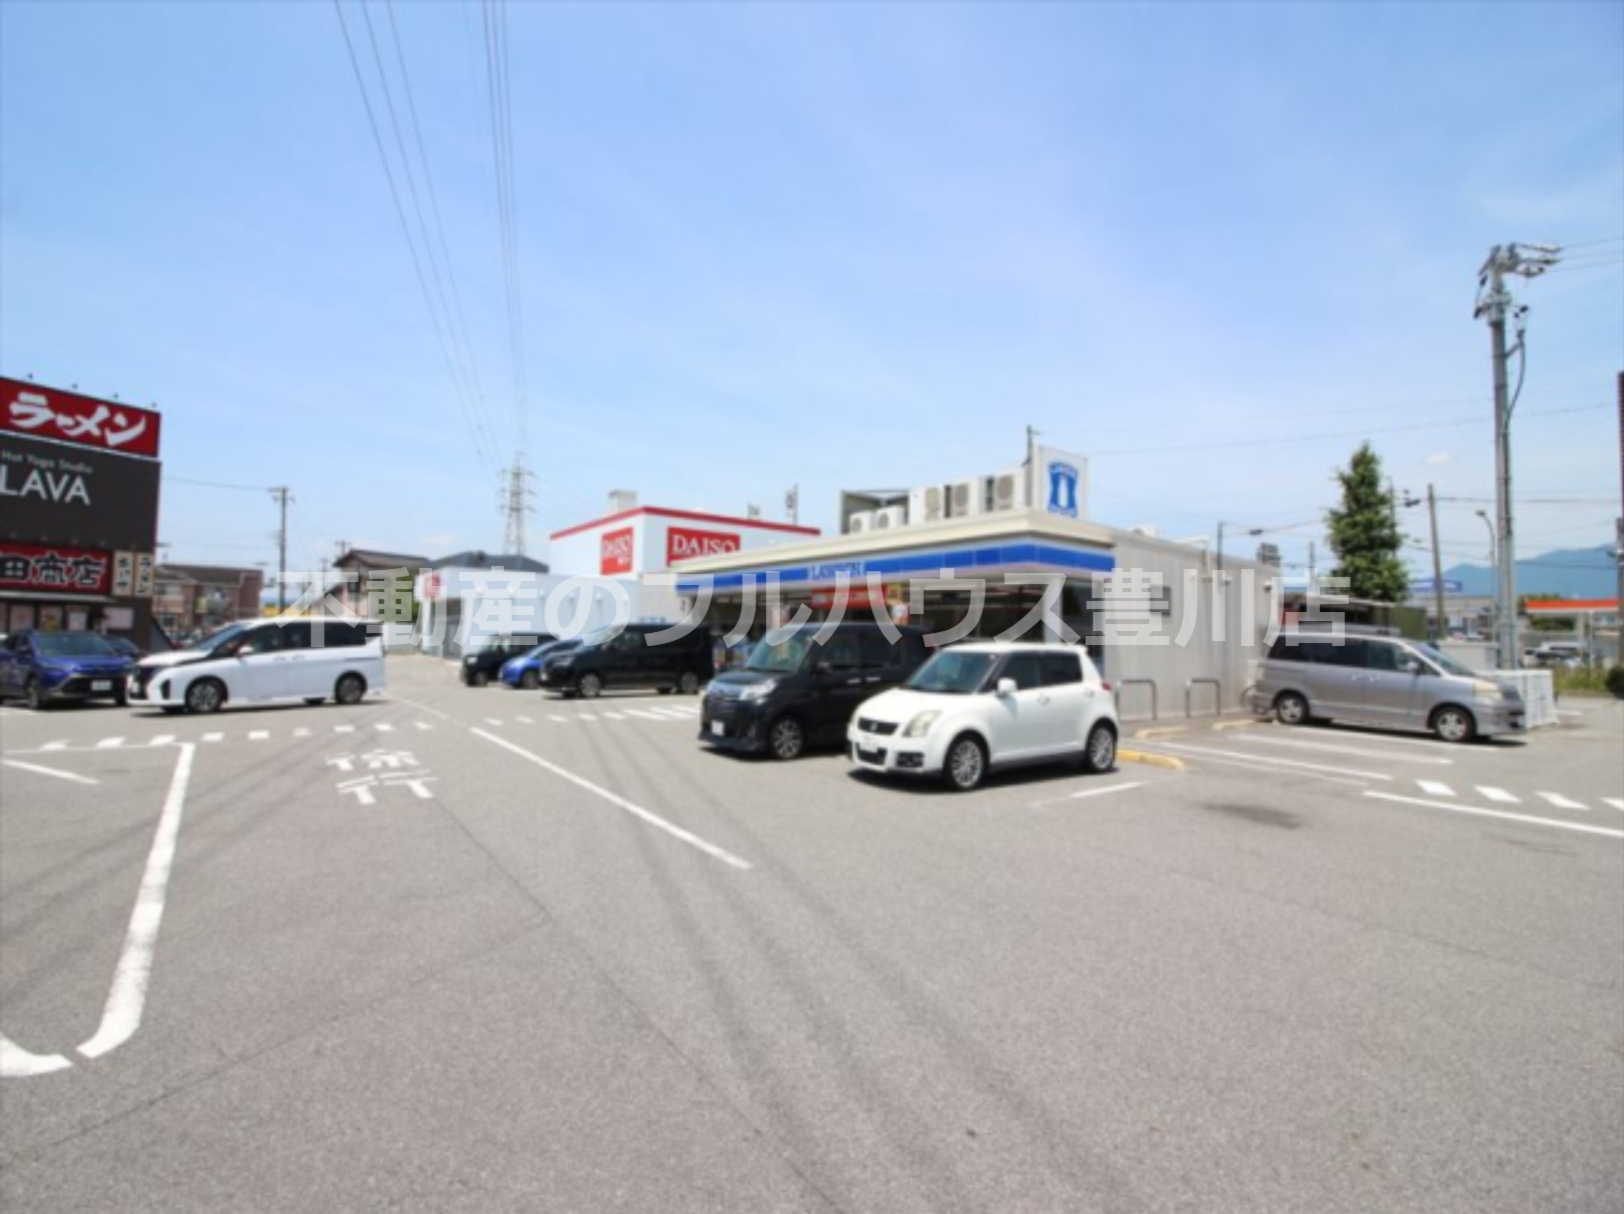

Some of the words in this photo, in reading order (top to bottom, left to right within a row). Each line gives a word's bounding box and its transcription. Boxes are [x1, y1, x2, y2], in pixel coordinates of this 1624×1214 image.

[9, 391, 146, 446] ラーメン
[0, 464, 91, 505] LAVA
[672, 535, 737, 556] DAISO
